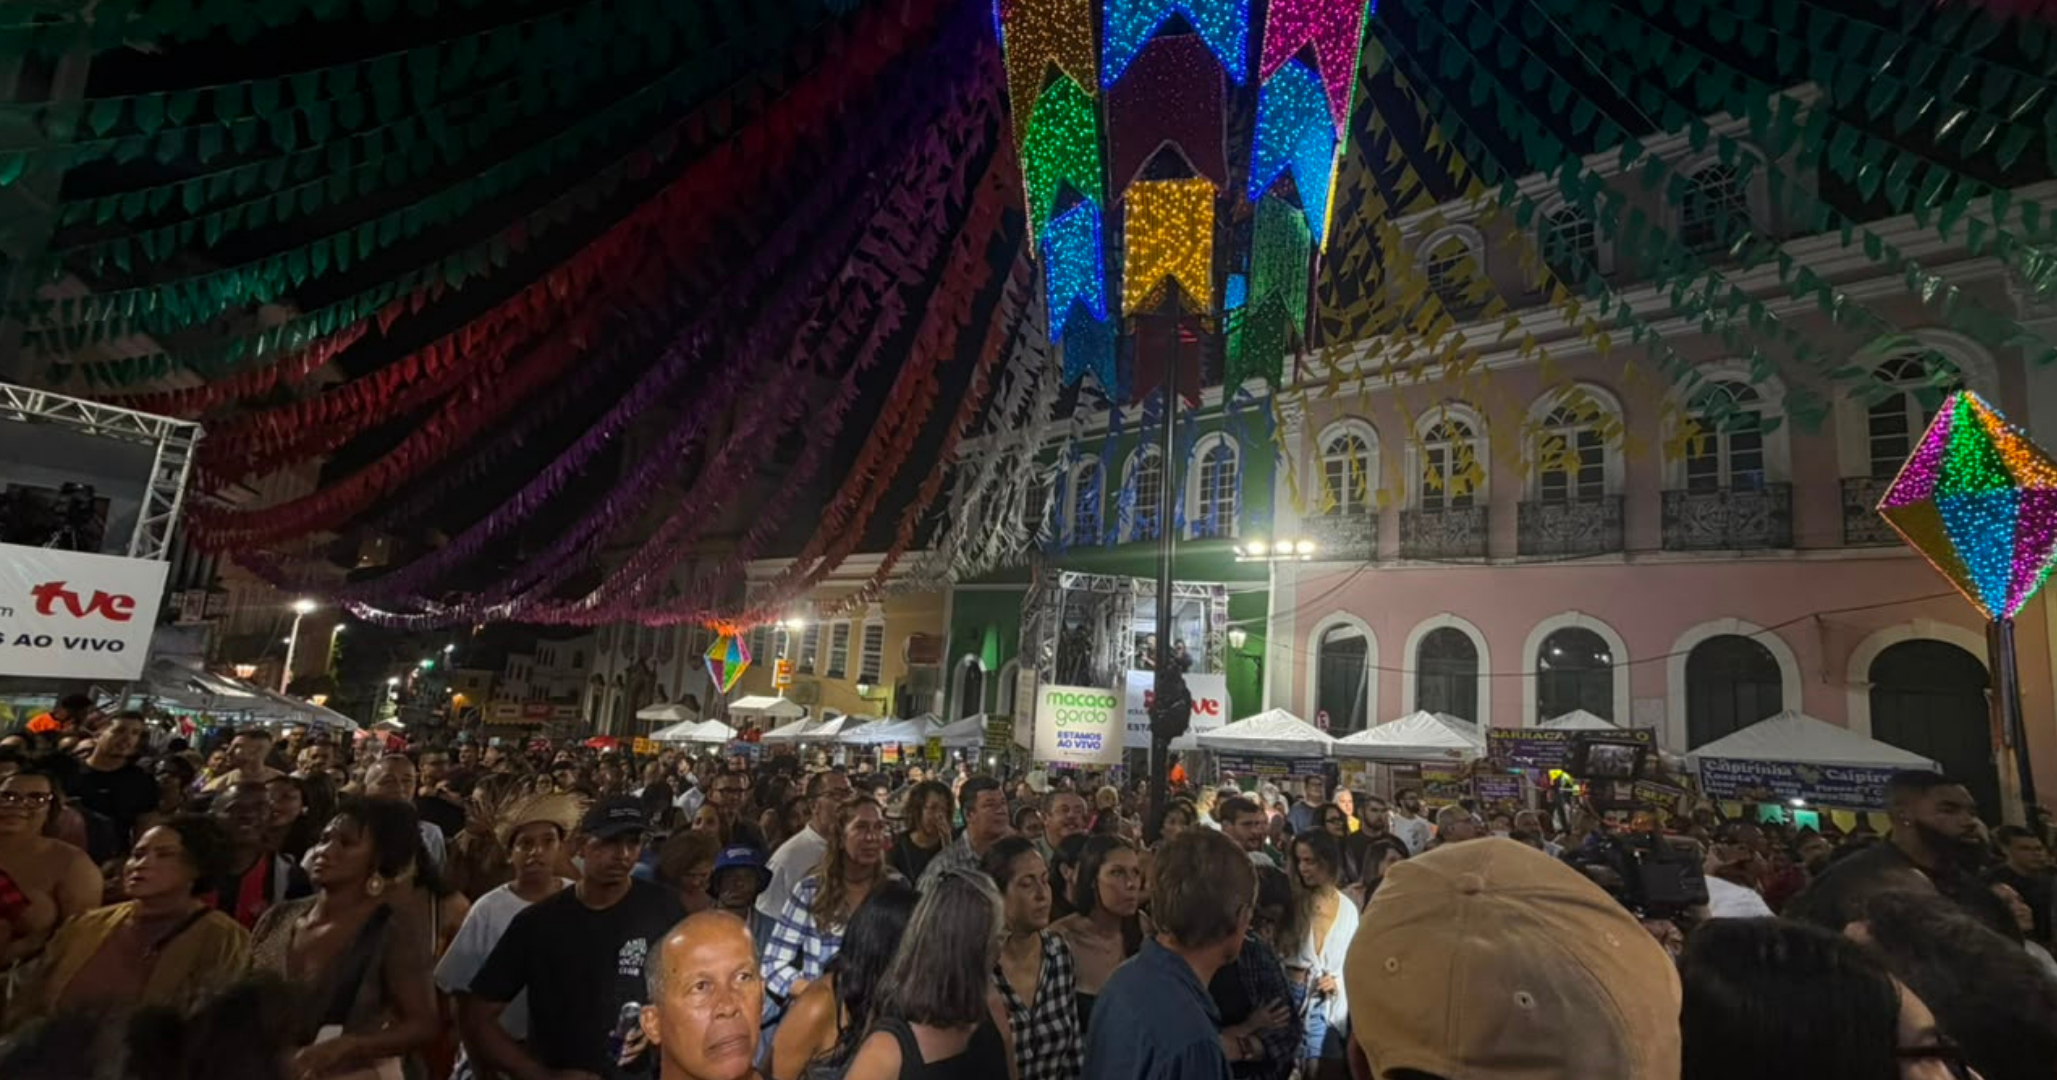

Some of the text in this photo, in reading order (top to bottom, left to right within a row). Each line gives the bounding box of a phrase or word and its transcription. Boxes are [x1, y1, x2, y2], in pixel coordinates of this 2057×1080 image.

[31, 581, 136, 622] tve
[13, 634, 53, 648] AO
[63, 636, 125, 652] VIVO
[1046, 692, 1117, 709] macaco
[1190, 697, 1219, 716] ve
[1055, 708, 1107, 727] gordo
[1056, 740, 1101, 750] AO VIVO
[1057, 731, 1102, 741] ESTAMOS
[1705, 758, 1793, 776] Caipirinha
